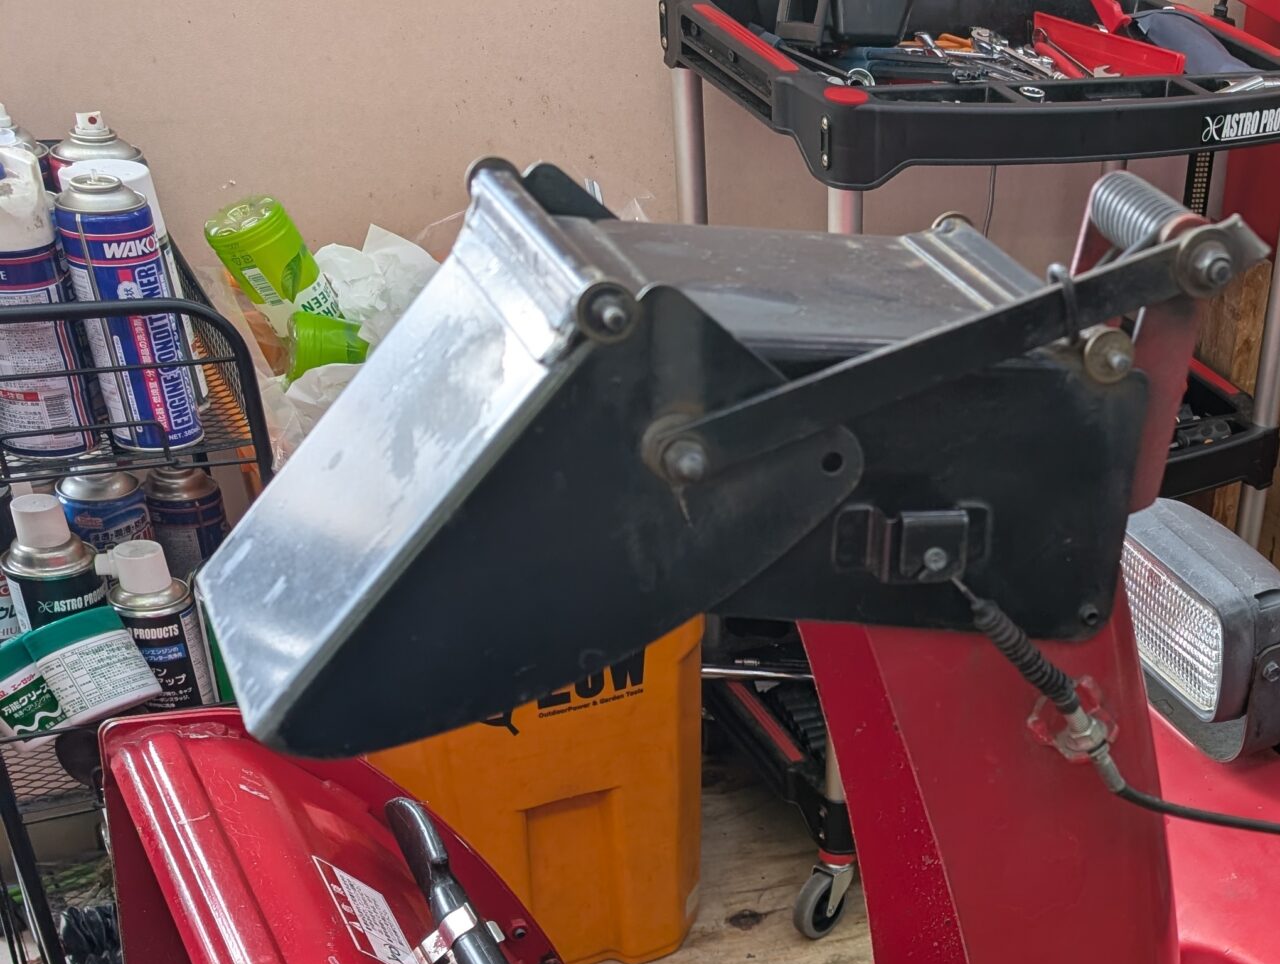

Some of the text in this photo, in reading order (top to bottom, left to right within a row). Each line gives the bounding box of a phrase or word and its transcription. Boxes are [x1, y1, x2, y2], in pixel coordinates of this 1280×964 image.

[1221, 109, 1260, 139] ASTRO
[163, 370, 194, 430] ENGINE
[53, 598, 83, 613] ASTRO
[133, 624, 179, 640] PRODUCTS
